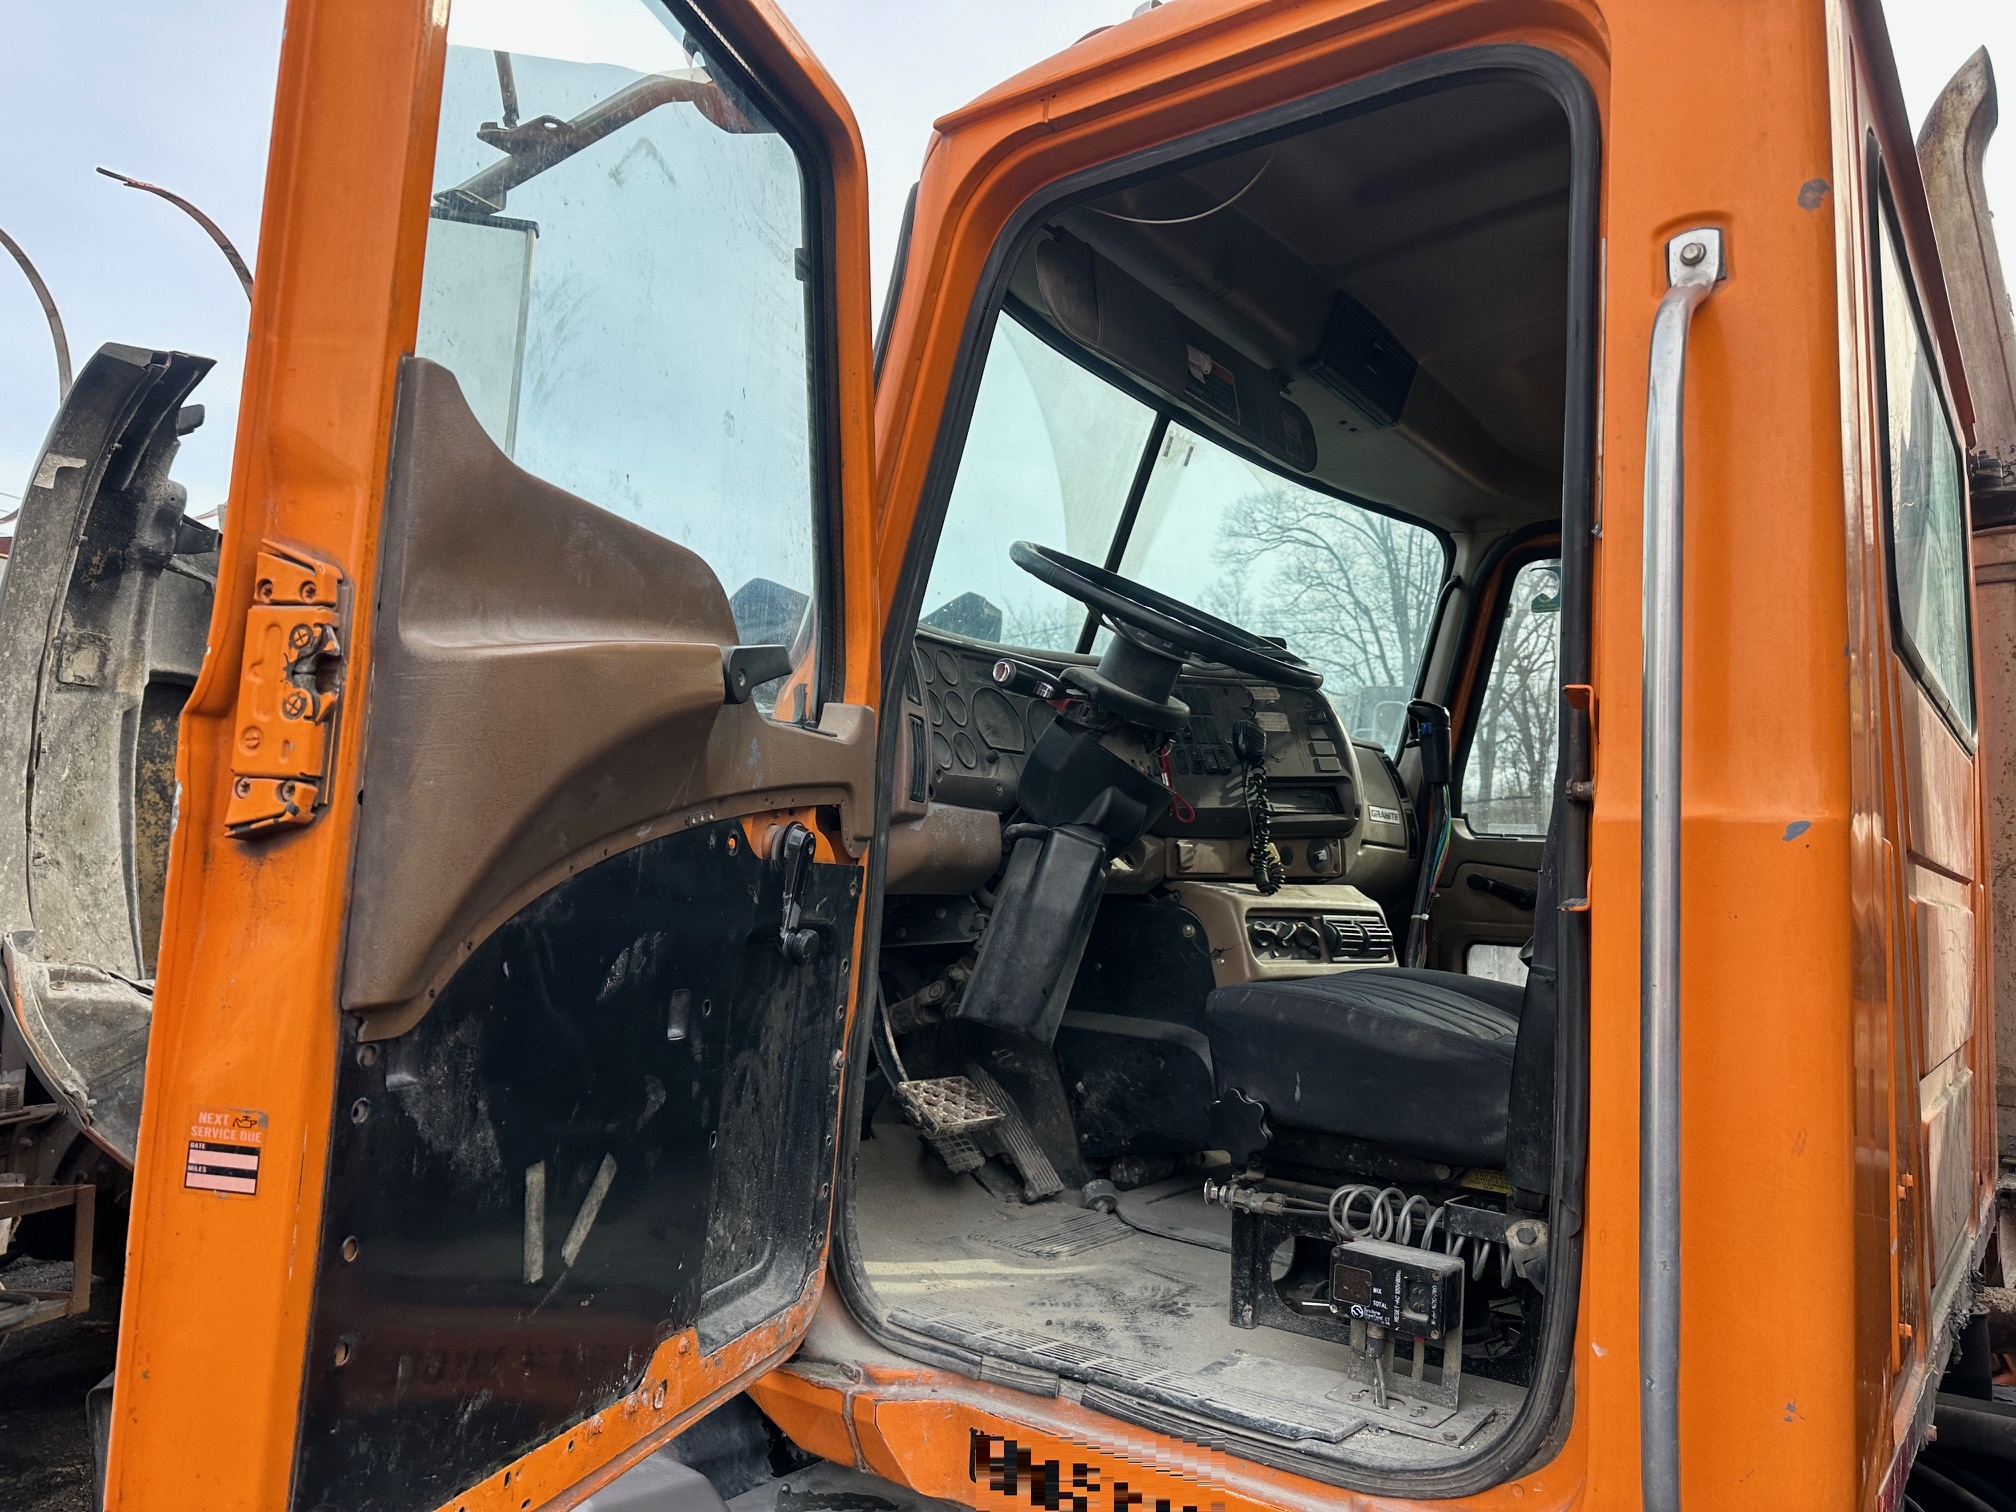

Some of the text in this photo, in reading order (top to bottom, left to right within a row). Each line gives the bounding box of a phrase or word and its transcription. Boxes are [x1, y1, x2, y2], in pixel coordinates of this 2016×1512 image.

[1371, 810, 1399, 820] GRANITE
[198, 1112, 230, 1126] NEXT
[190, 1125, 262, 1143] SERVICE DUE
[190, 1142, 206, 1150] DATE
[187, 1165, 207, 1173] MILES
[1373, 1300, 1388, 1310] TOTAL
